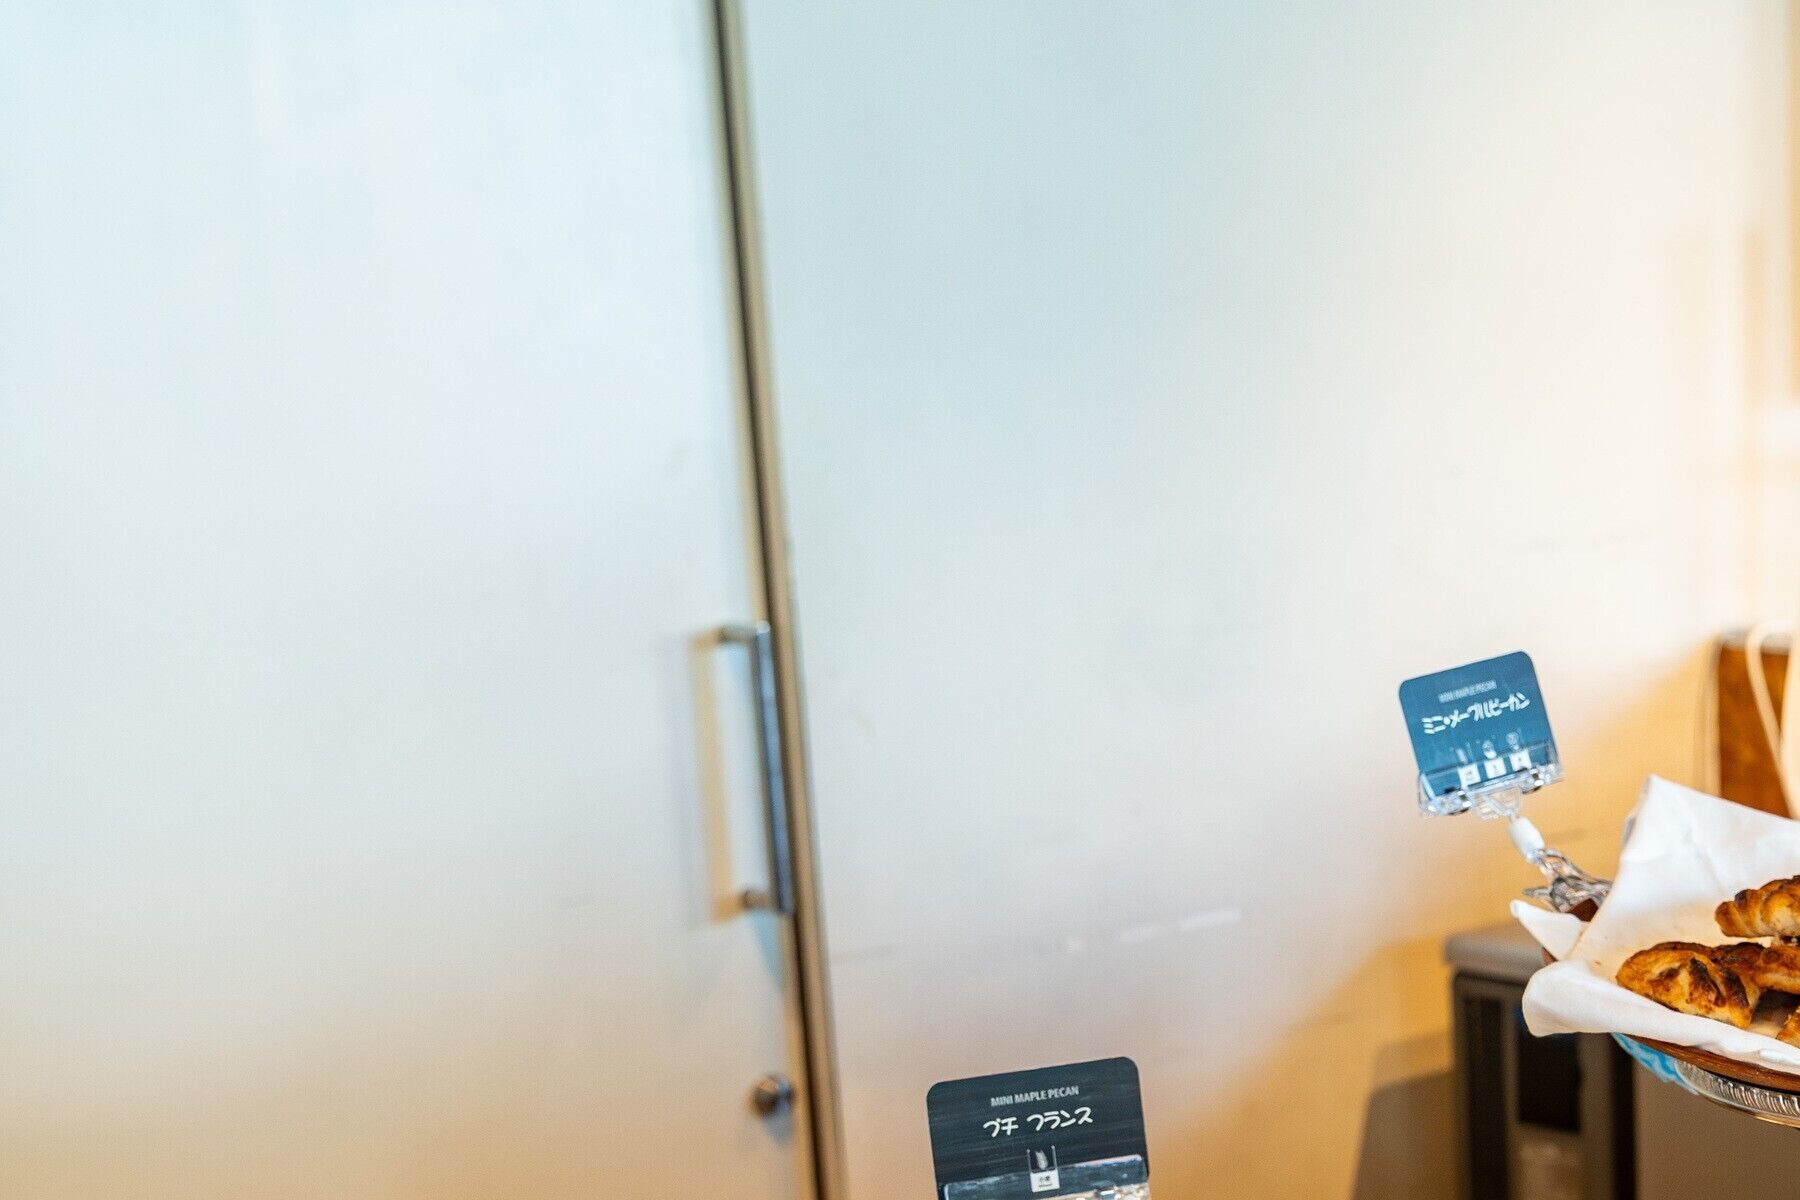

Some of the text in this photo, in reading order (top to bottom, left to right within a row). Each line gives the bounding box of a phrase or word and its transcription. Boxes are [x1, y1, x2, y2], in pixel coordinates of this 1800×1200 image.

[990, 1085, 1080, 1107] MINI MAPLE PECAN
[1026, 1106, 1094, 1132] フランス
